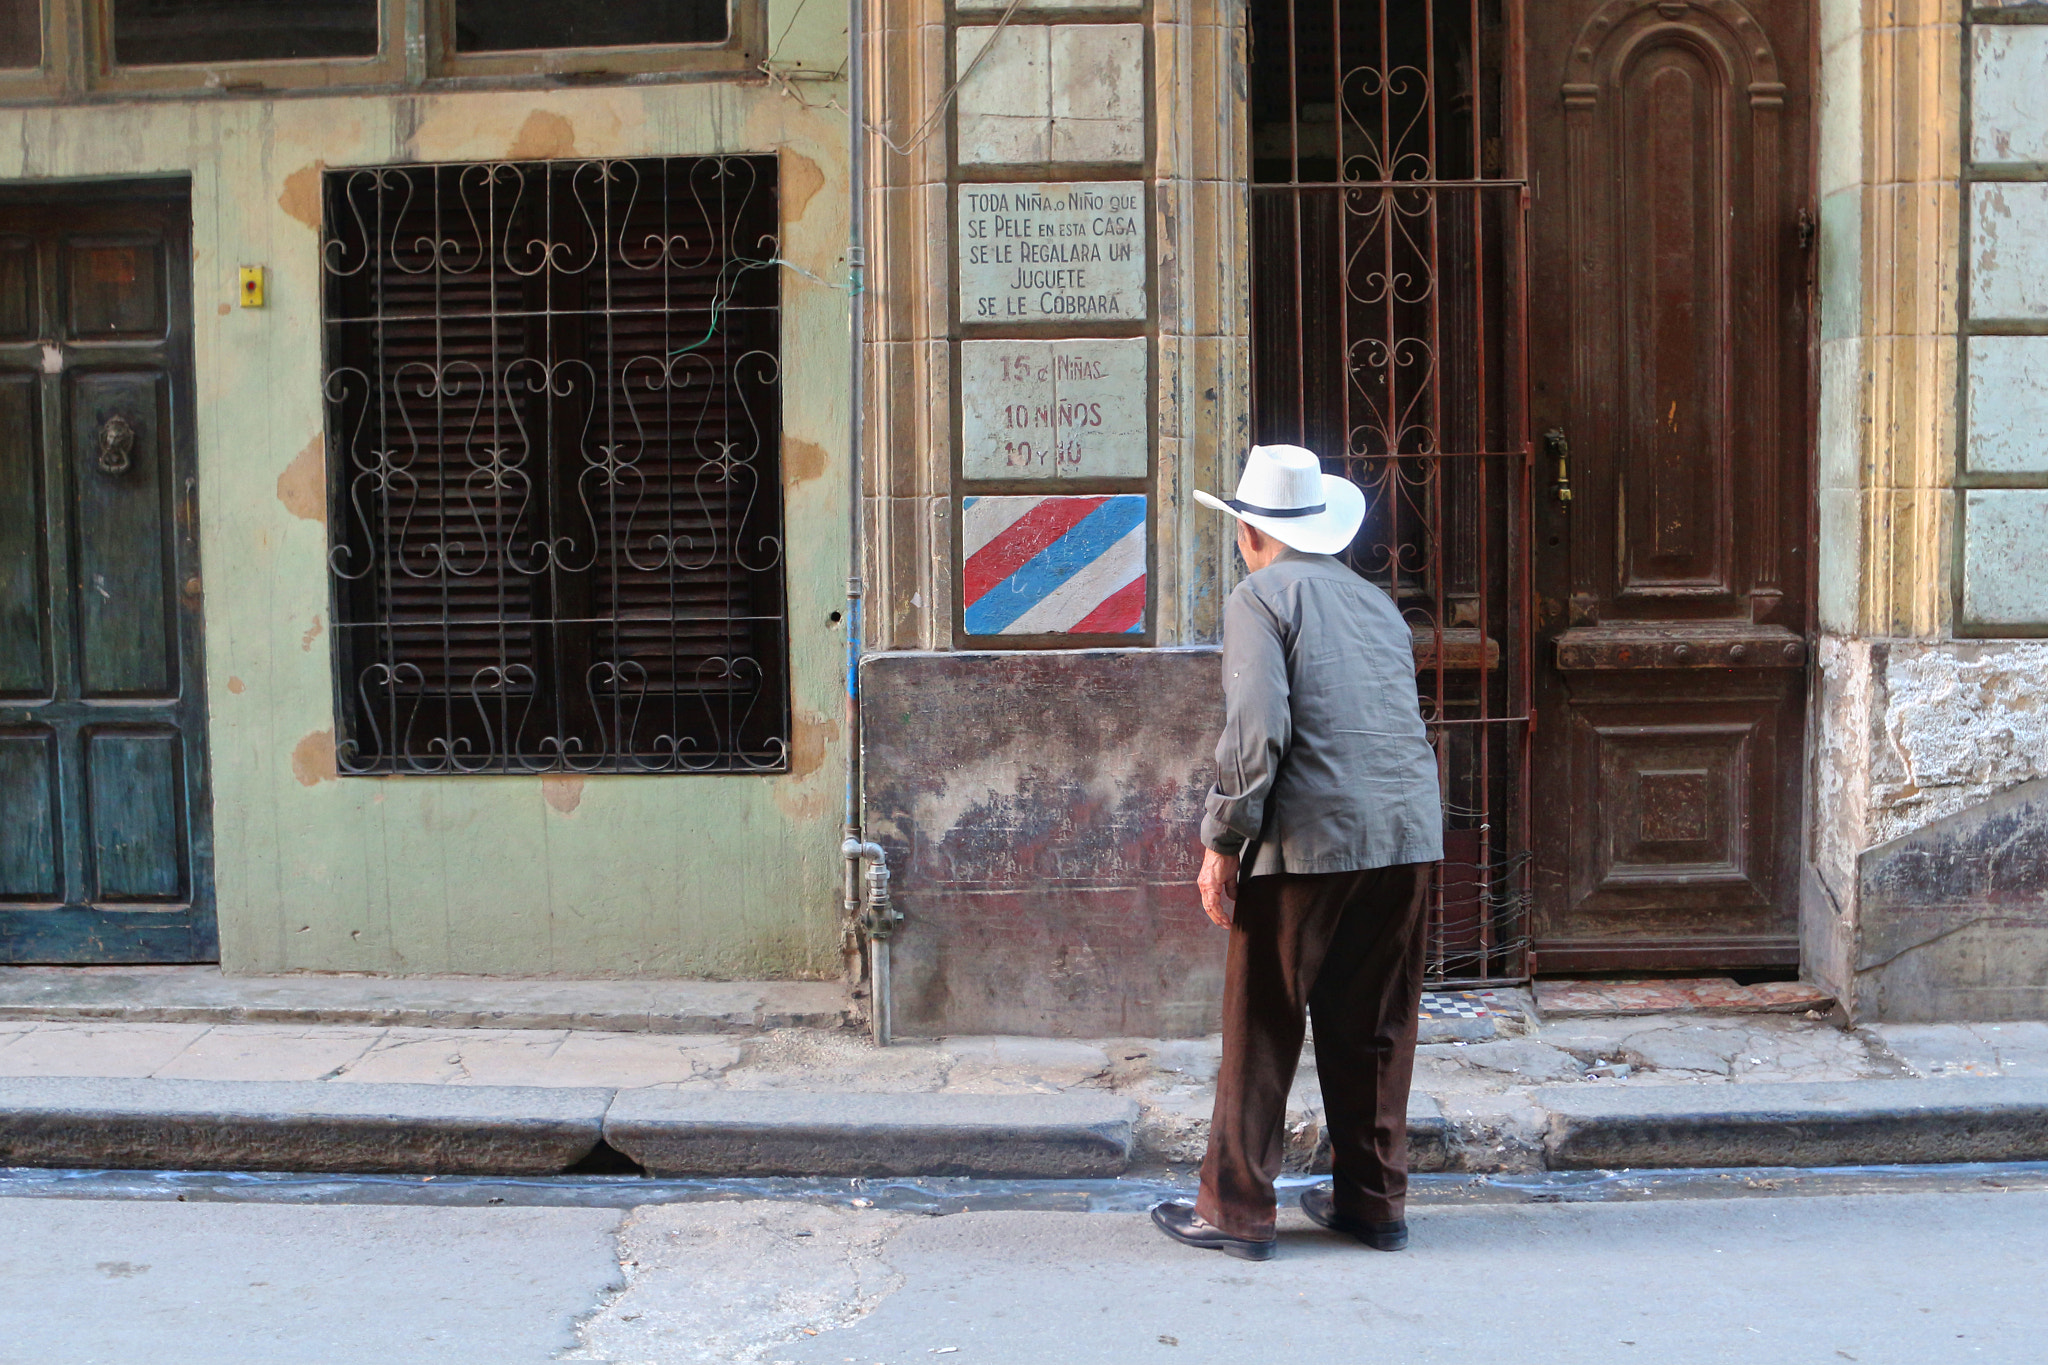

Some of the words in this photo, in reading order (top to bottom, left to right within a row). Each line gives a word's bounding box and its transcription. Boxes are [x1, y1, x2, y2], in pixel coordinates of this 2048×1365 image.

[968, 193, 1009, 213] TODA
[1068, 192, 1104, 211] NIÑO
[1109, 195, 1137, 213] QUE
[968, 219, 987, 239] SE
[995, 215, 1032, 238] PELE
[1038, 223, 1054, 237] EN
[1059, 223, 1087, 237] ESTA
[1092, 217, 1137, 237] CASA
[969, 245, 989, 264] SE
[996, 244, 1013, 263] LE
[1020, 241, 1102, 263] REGALARA
[1109, 243, 1131, 262] UN
[1010, 267, 1086, 289] JUGUETE
[977, 297, 997, 315] SE
[1007, 296, 1027, 315] LE
[1040, 291, 1120, 314] COBRARA
[1005, 404, 1029, 429] 10
[1035, 398, 1103, 428] NIÑOS
